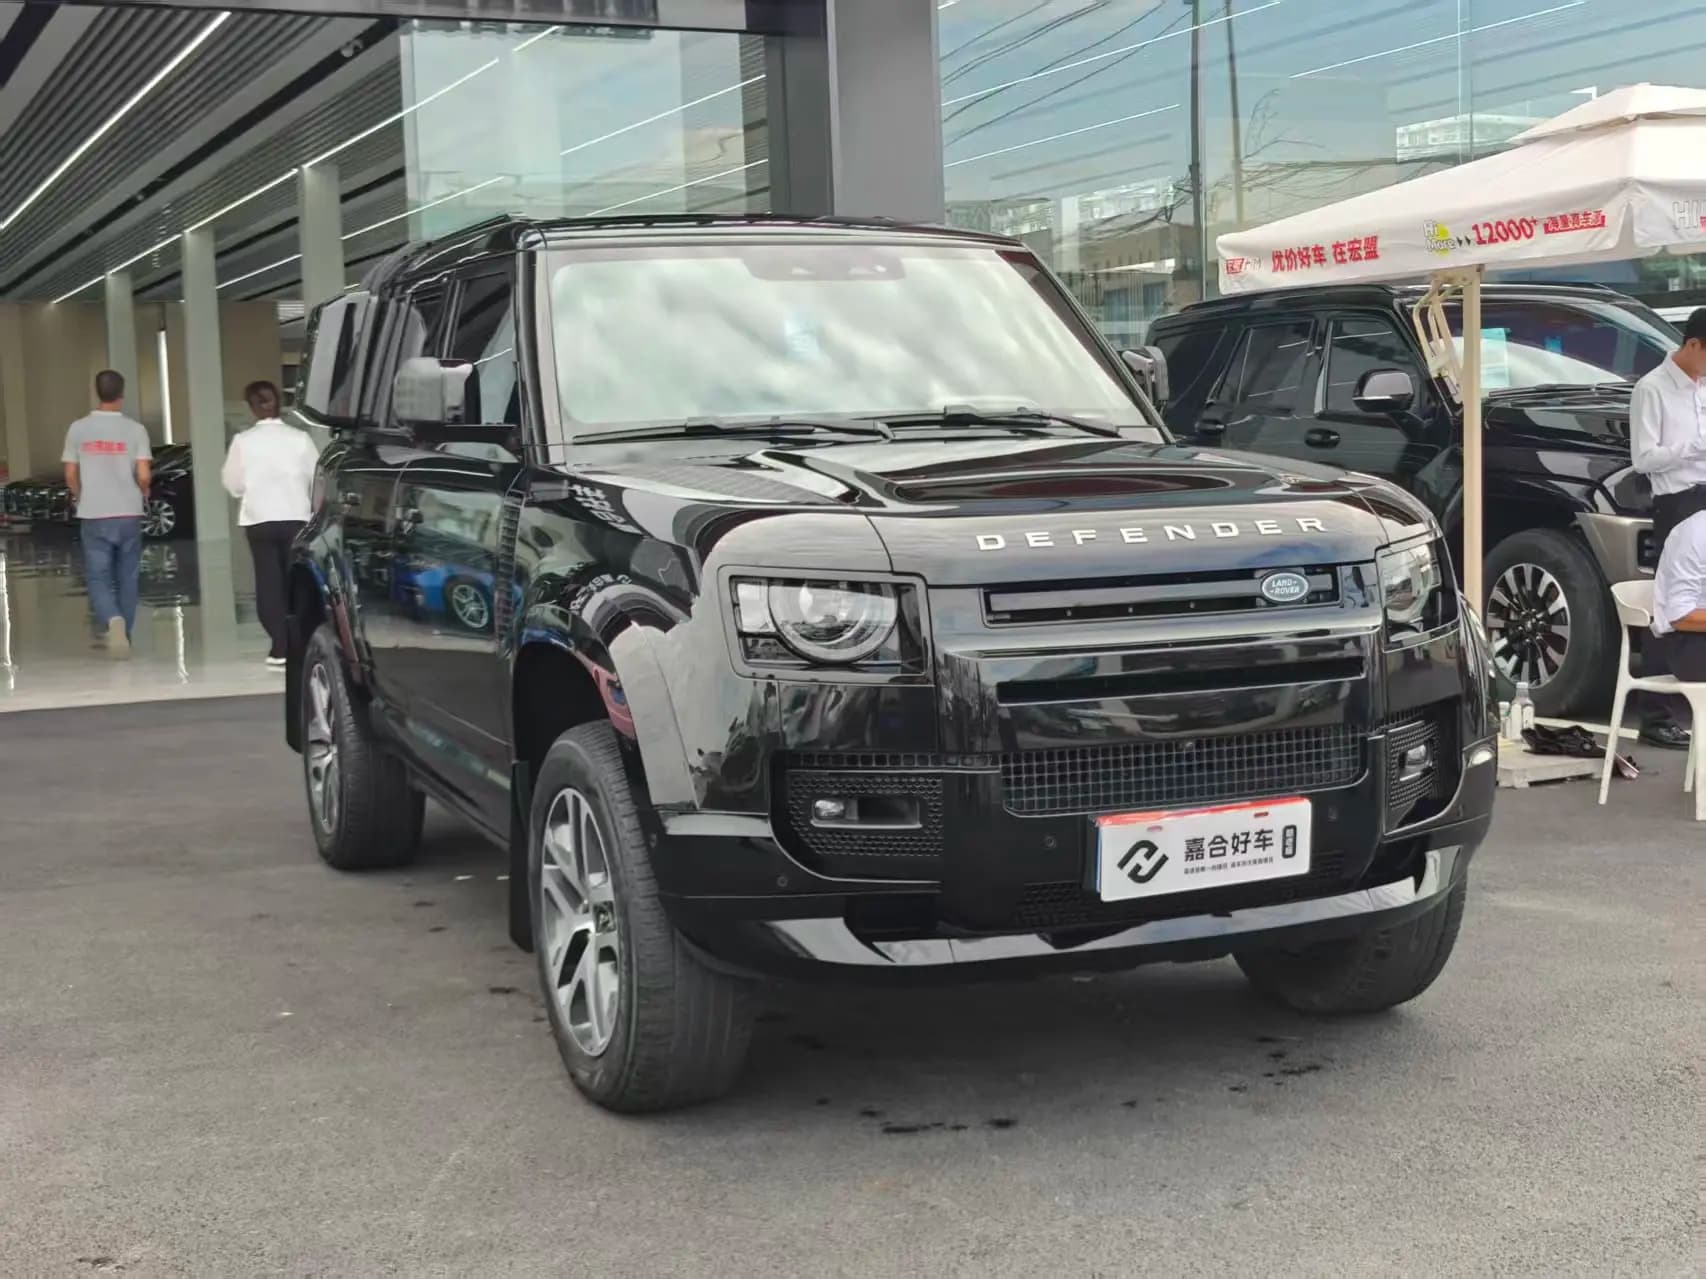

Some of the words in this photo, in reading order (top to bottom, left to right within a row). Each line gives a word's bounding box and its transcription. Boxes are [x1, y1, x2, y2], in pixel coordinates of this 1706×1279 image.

[1271, 244, 1328, 272] 优价好车
[1332, 235, 1380, 265] 在宏盟
[976, 517, 1328, 552] DEFENDER
[1272, 578, 1292, 587] LAND
[1275, 585, 1300, 593] ROVER
[1184, 829, 1274, 862] 嘉合好车
